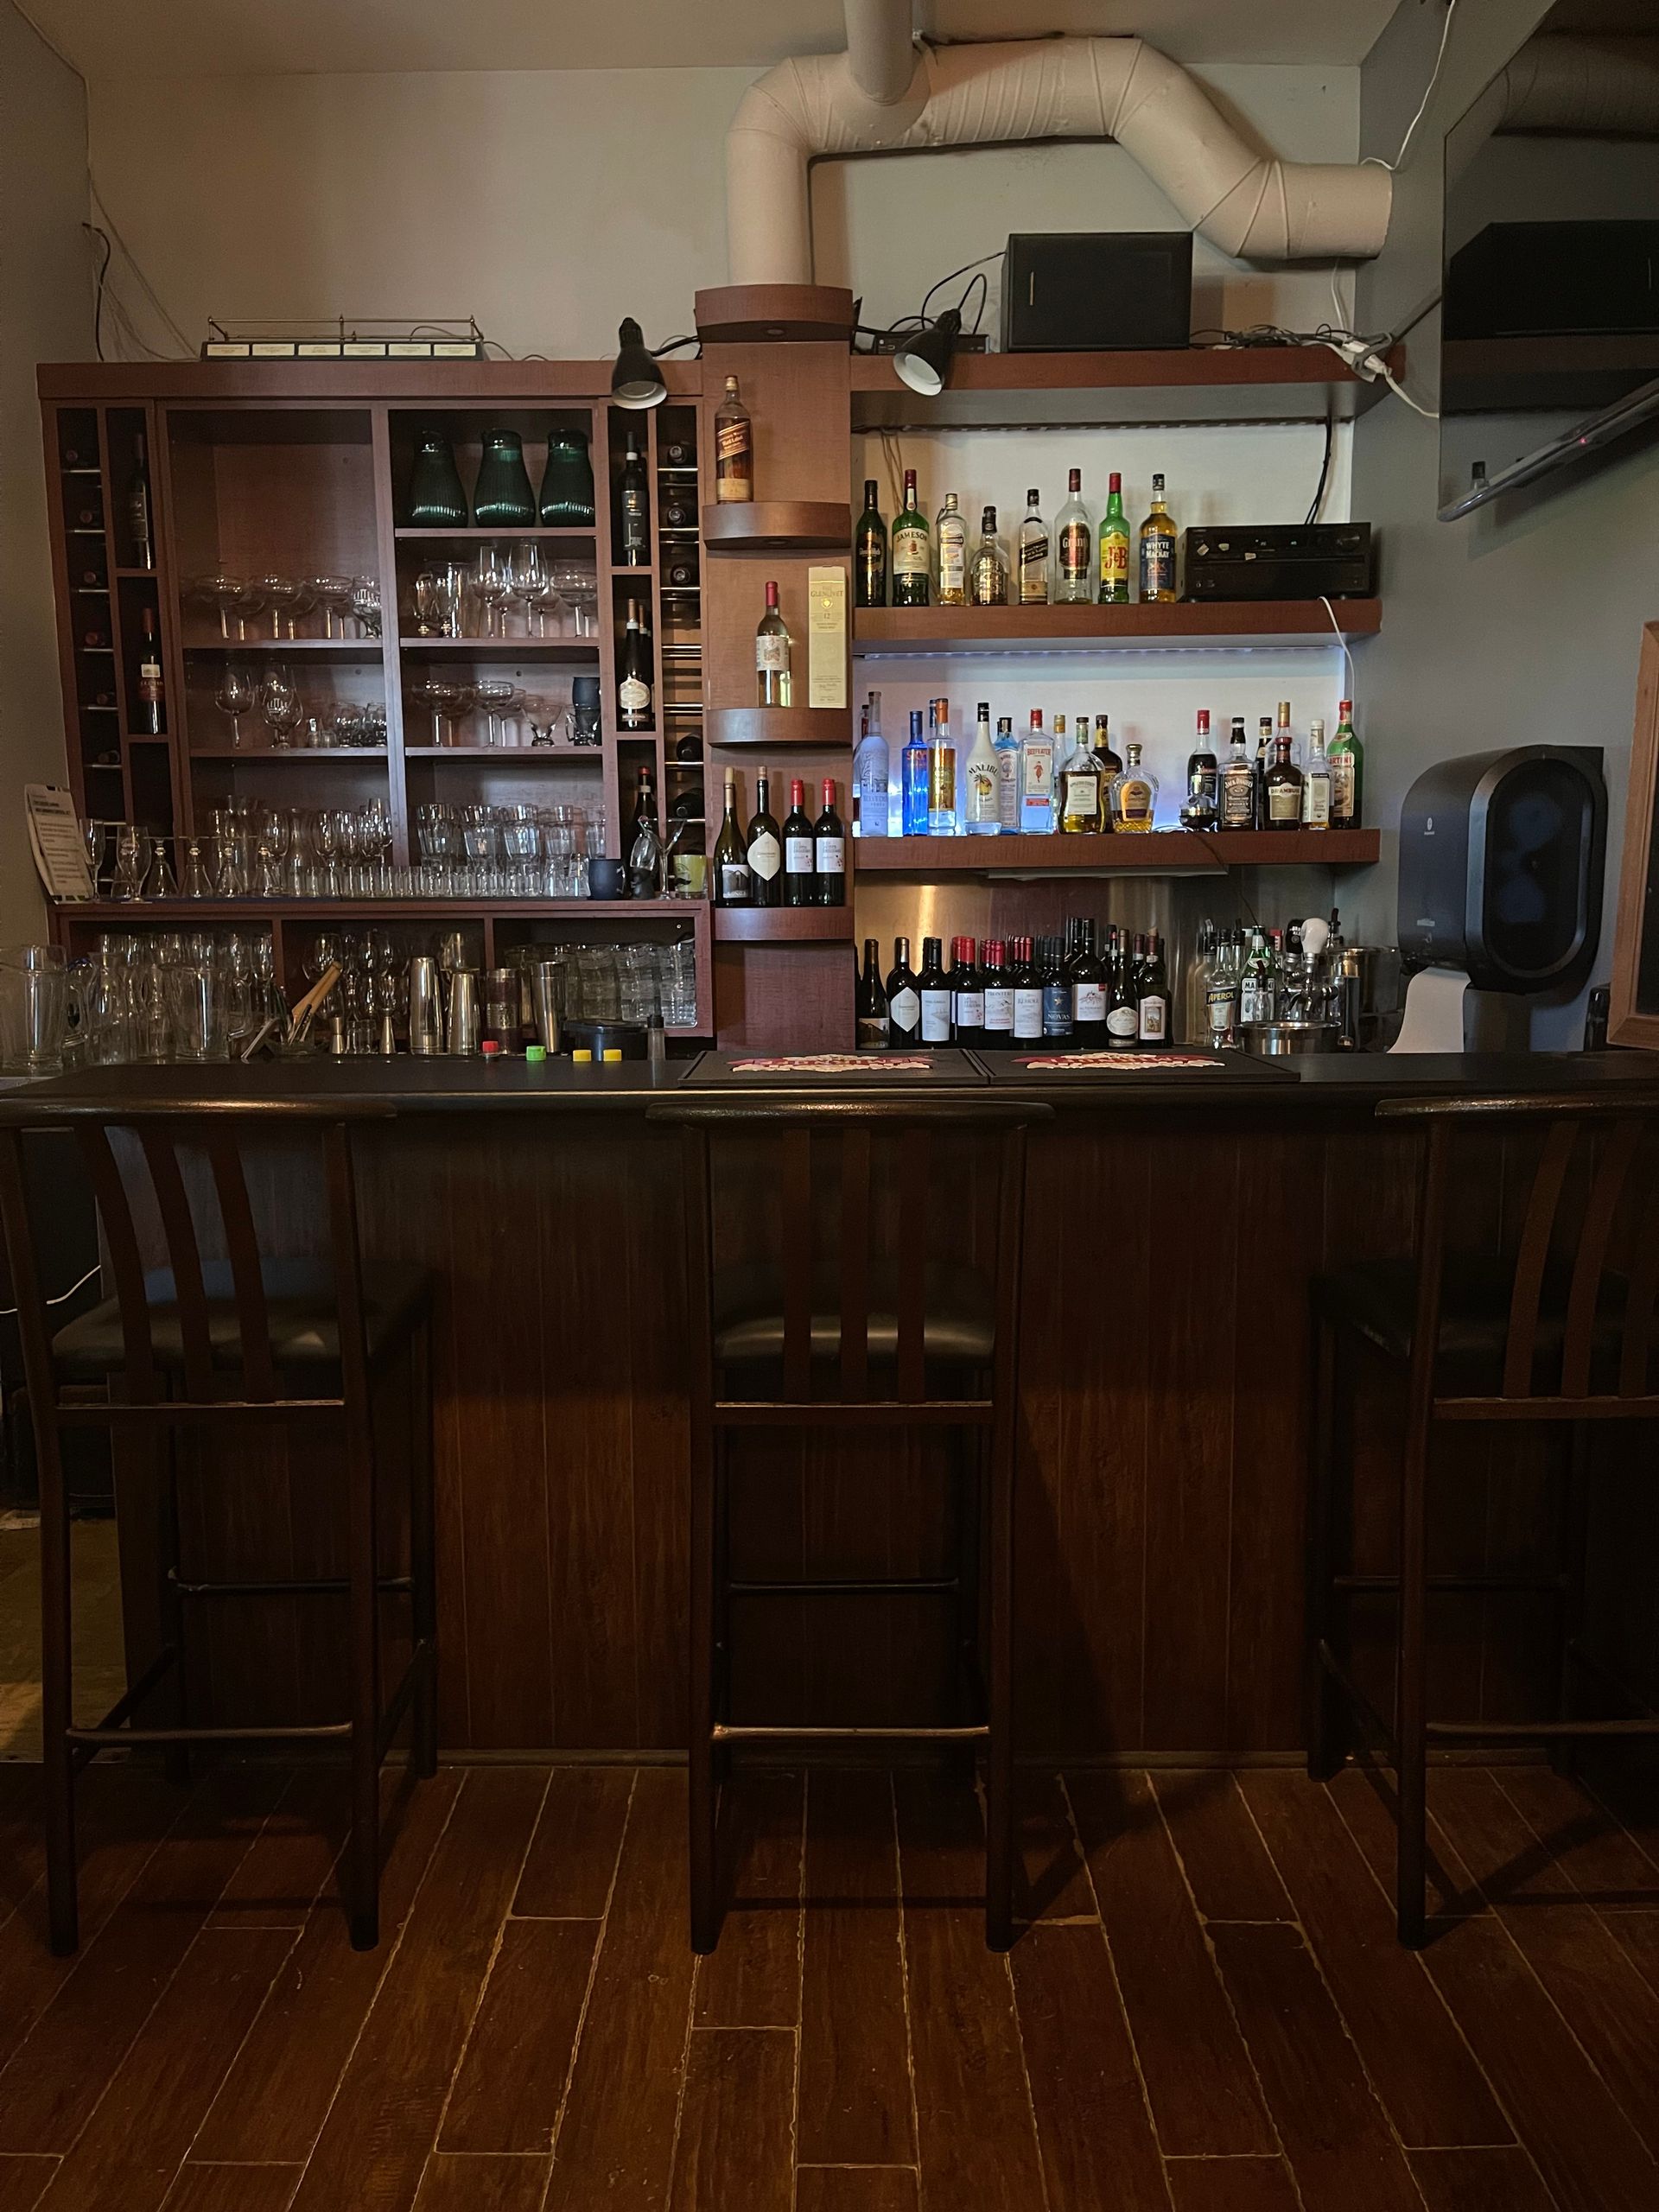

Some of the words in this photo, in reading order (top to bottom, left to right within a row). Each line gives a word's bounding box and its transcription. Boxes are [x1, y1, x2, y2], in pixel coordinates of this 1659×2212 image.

[897, 531, 927, 543] JAMESON
[1146, 541, 1170, 550] WHYTE
[1146, 550, 1170, 559] MACKAY
[969, 764, 999, 776] MALIBU
[1208, 991, 1235, 1002] APEROL
